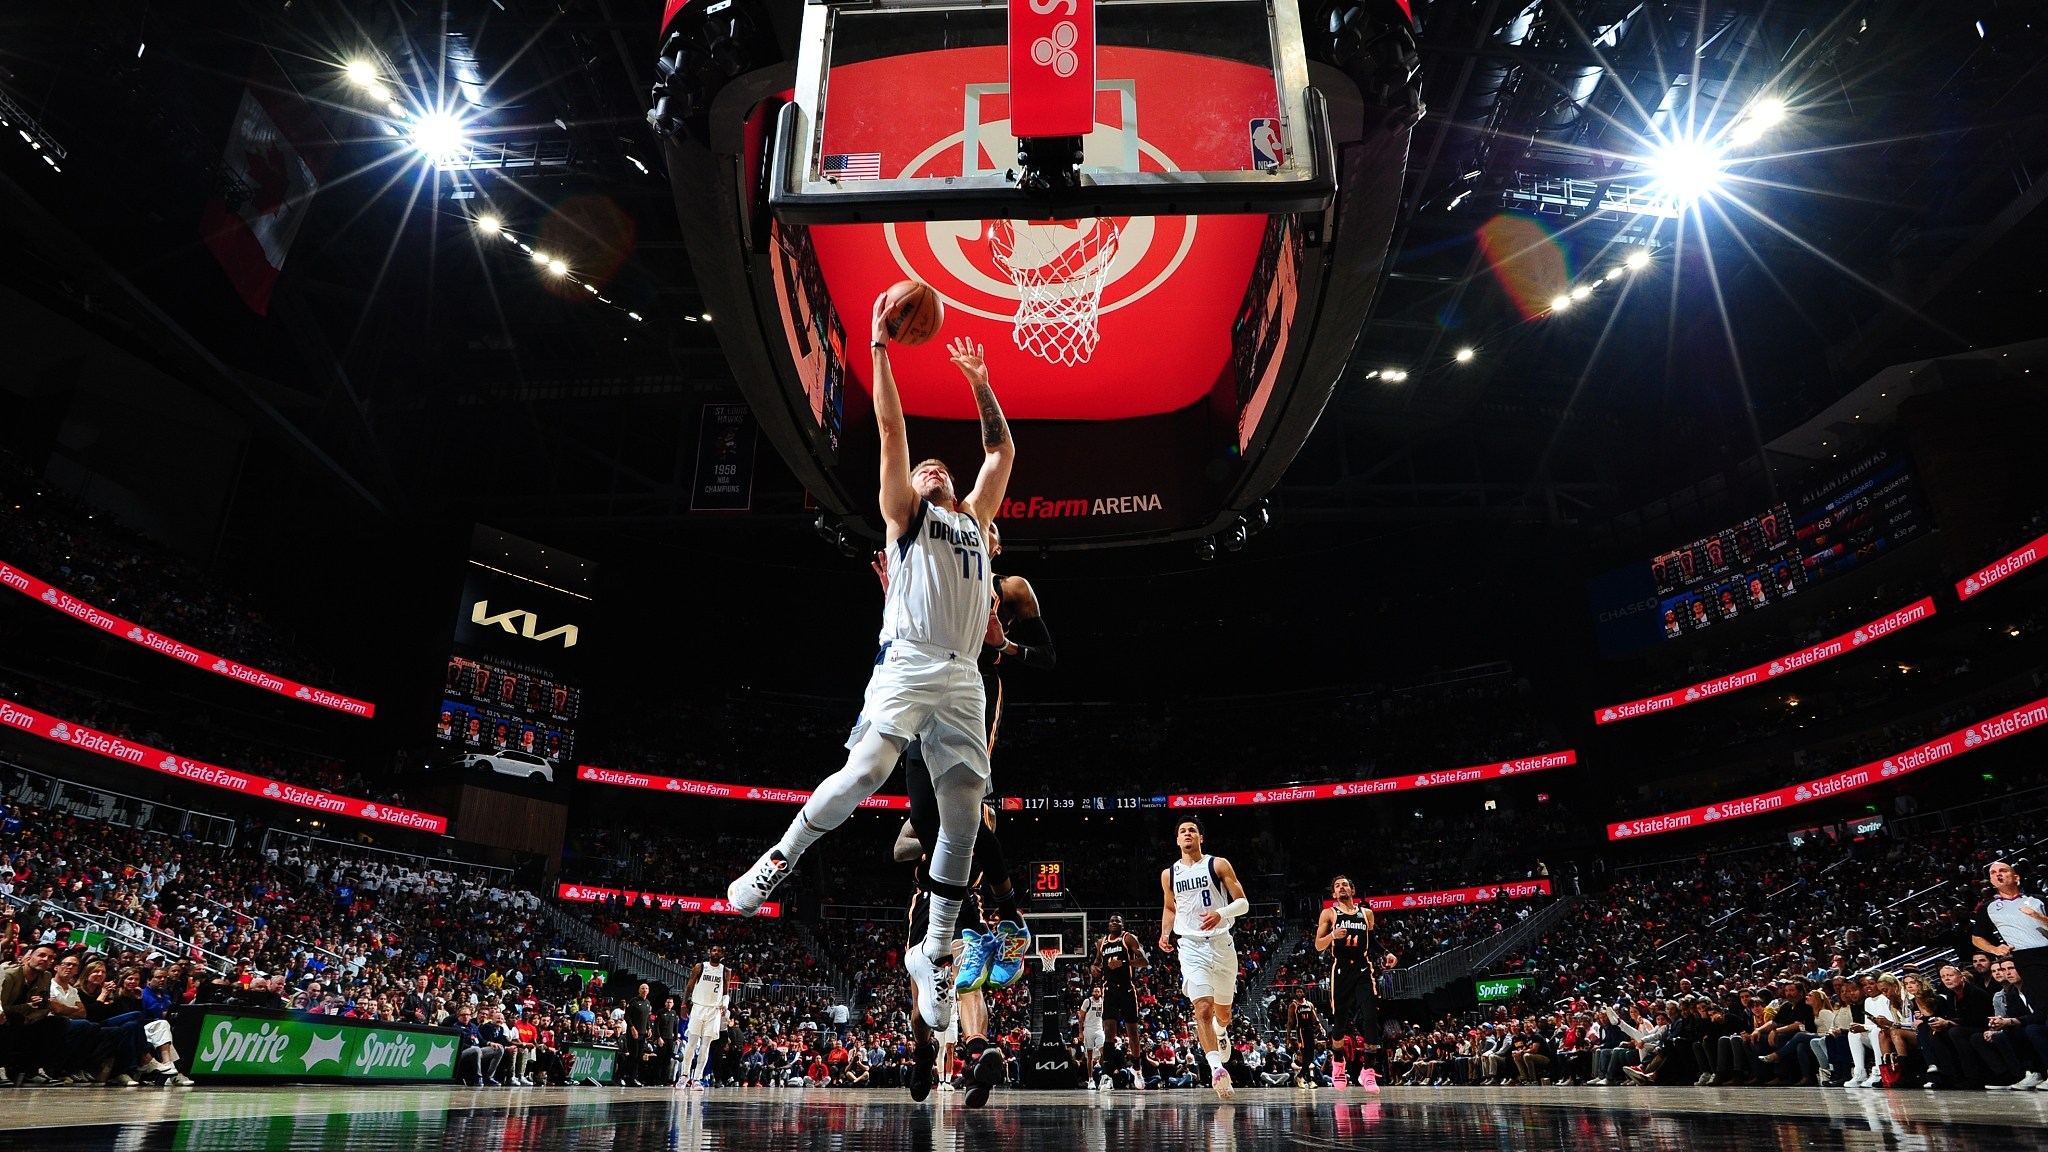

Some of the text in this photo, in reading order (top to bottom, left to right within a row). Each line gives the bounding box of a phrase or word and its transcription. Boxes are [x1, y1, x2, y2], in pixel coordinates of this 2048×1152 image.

[727, 406, 748, 415] LOUIS
[717, 415, 744, 423] HAWKS
[714, 464, 737, 475] 1958
[717, 476, 729, 484] NBA
[704, 485, 740, 493] CHAMPIONS
[1834, 480, 1874, 507] SCOREBOARD
[997, 493, 1163, 518] teFarm ARENA
[1818, 517, 1832, 530] 68
[1856, 497, 1869, 510] 53
[1883, 475, 1910, 493] QUARTER
[930, 521, 979, 548] DALLAS
[955, 548, 982, 581] 77
[1599, 601, 1646, 622] CHASE
[1025, 799, 1045, 809] 117
[1053, 799, 1074, 809] 3:39
[1117, 798, 1137, 809] 113
[1857, 822, 1881, 834] Sprite
[1040, 864, 1060, 874] 3:39
[1037, 873, 1058, 890] 20
[1176, 876, 1208, 893] DALLAS
[1201, 890, 1211, 907] 8
[1340, 920, 1366, 931] Atlanta
[1345, 935, 1358, 947] 11
[702, 975, 722, 983] DALLAS
[713, 984, 720, 993] 2
[1478, 983, 1509, 998] Sprite
[200, 1021, 289, 1072] Sprite
[356, 1033, 416, 1074] Sprite
